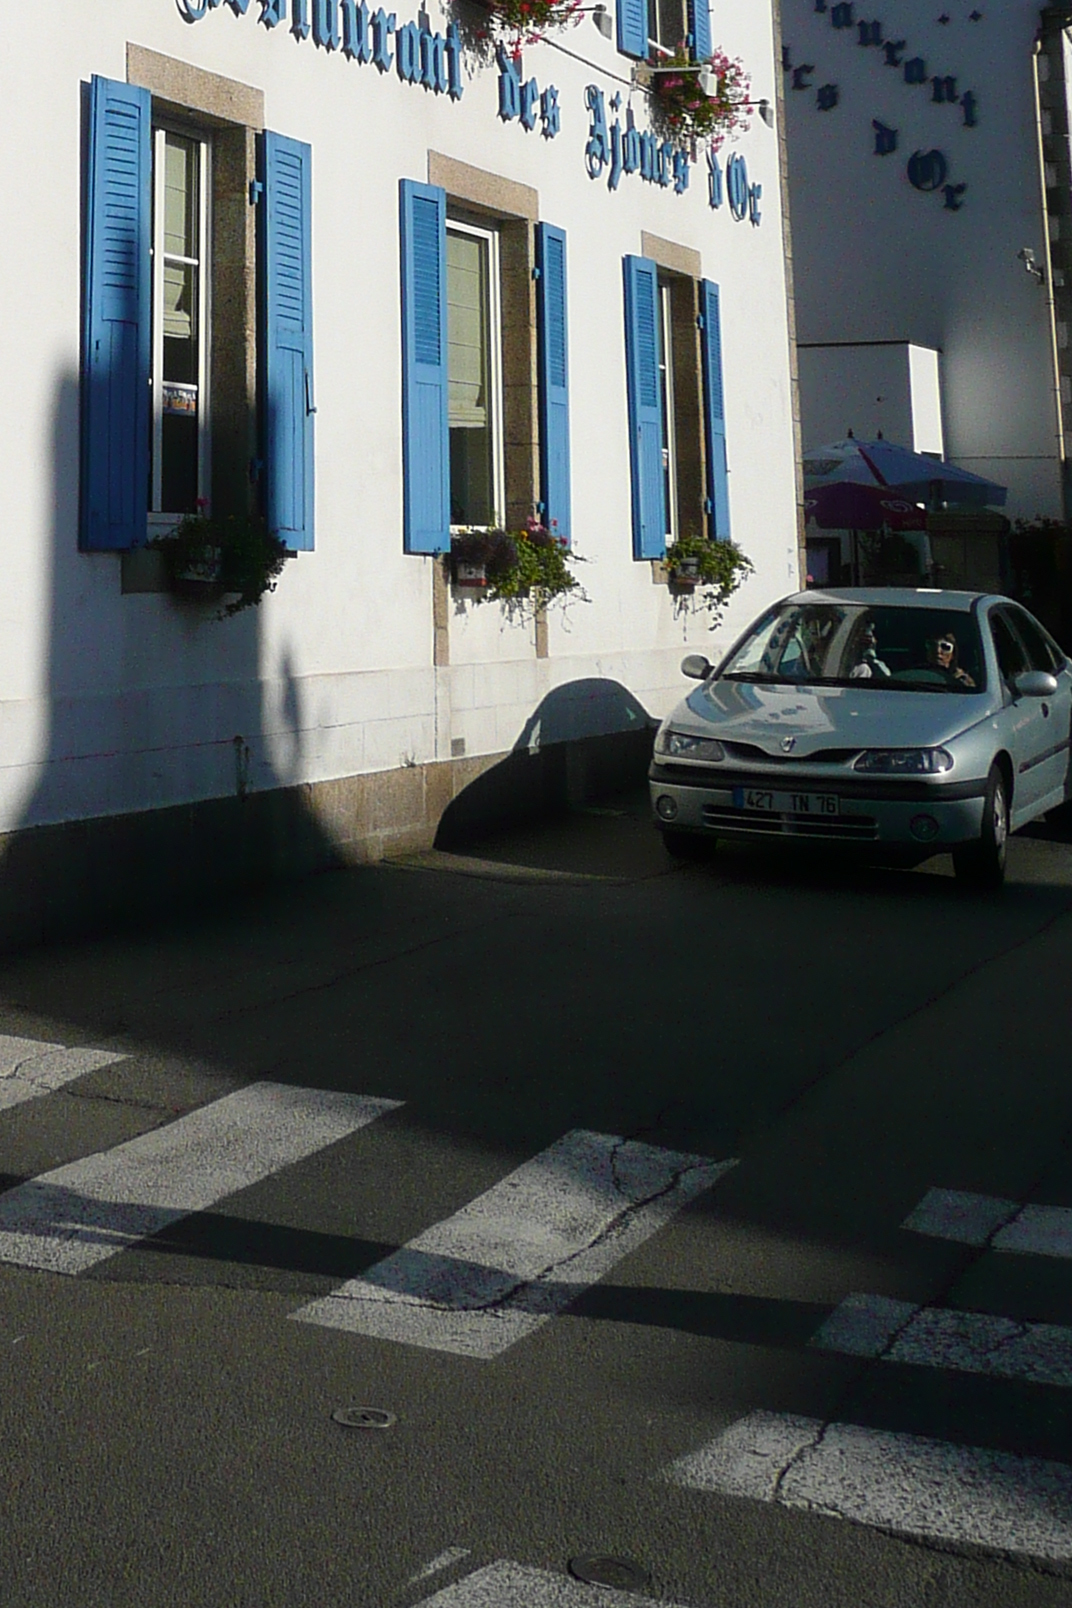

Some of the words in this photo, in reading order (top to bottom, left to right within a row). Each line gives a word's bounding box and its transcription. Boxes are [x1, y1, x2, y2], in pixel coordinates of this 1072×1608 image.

[497, 40, 561, 142] des
[583, 83, 691, 196] Ajoncs
[746, 790, 774, 809] 427
[790, 794, 809, 812] TN
[815, 795, 837, 813] 76
